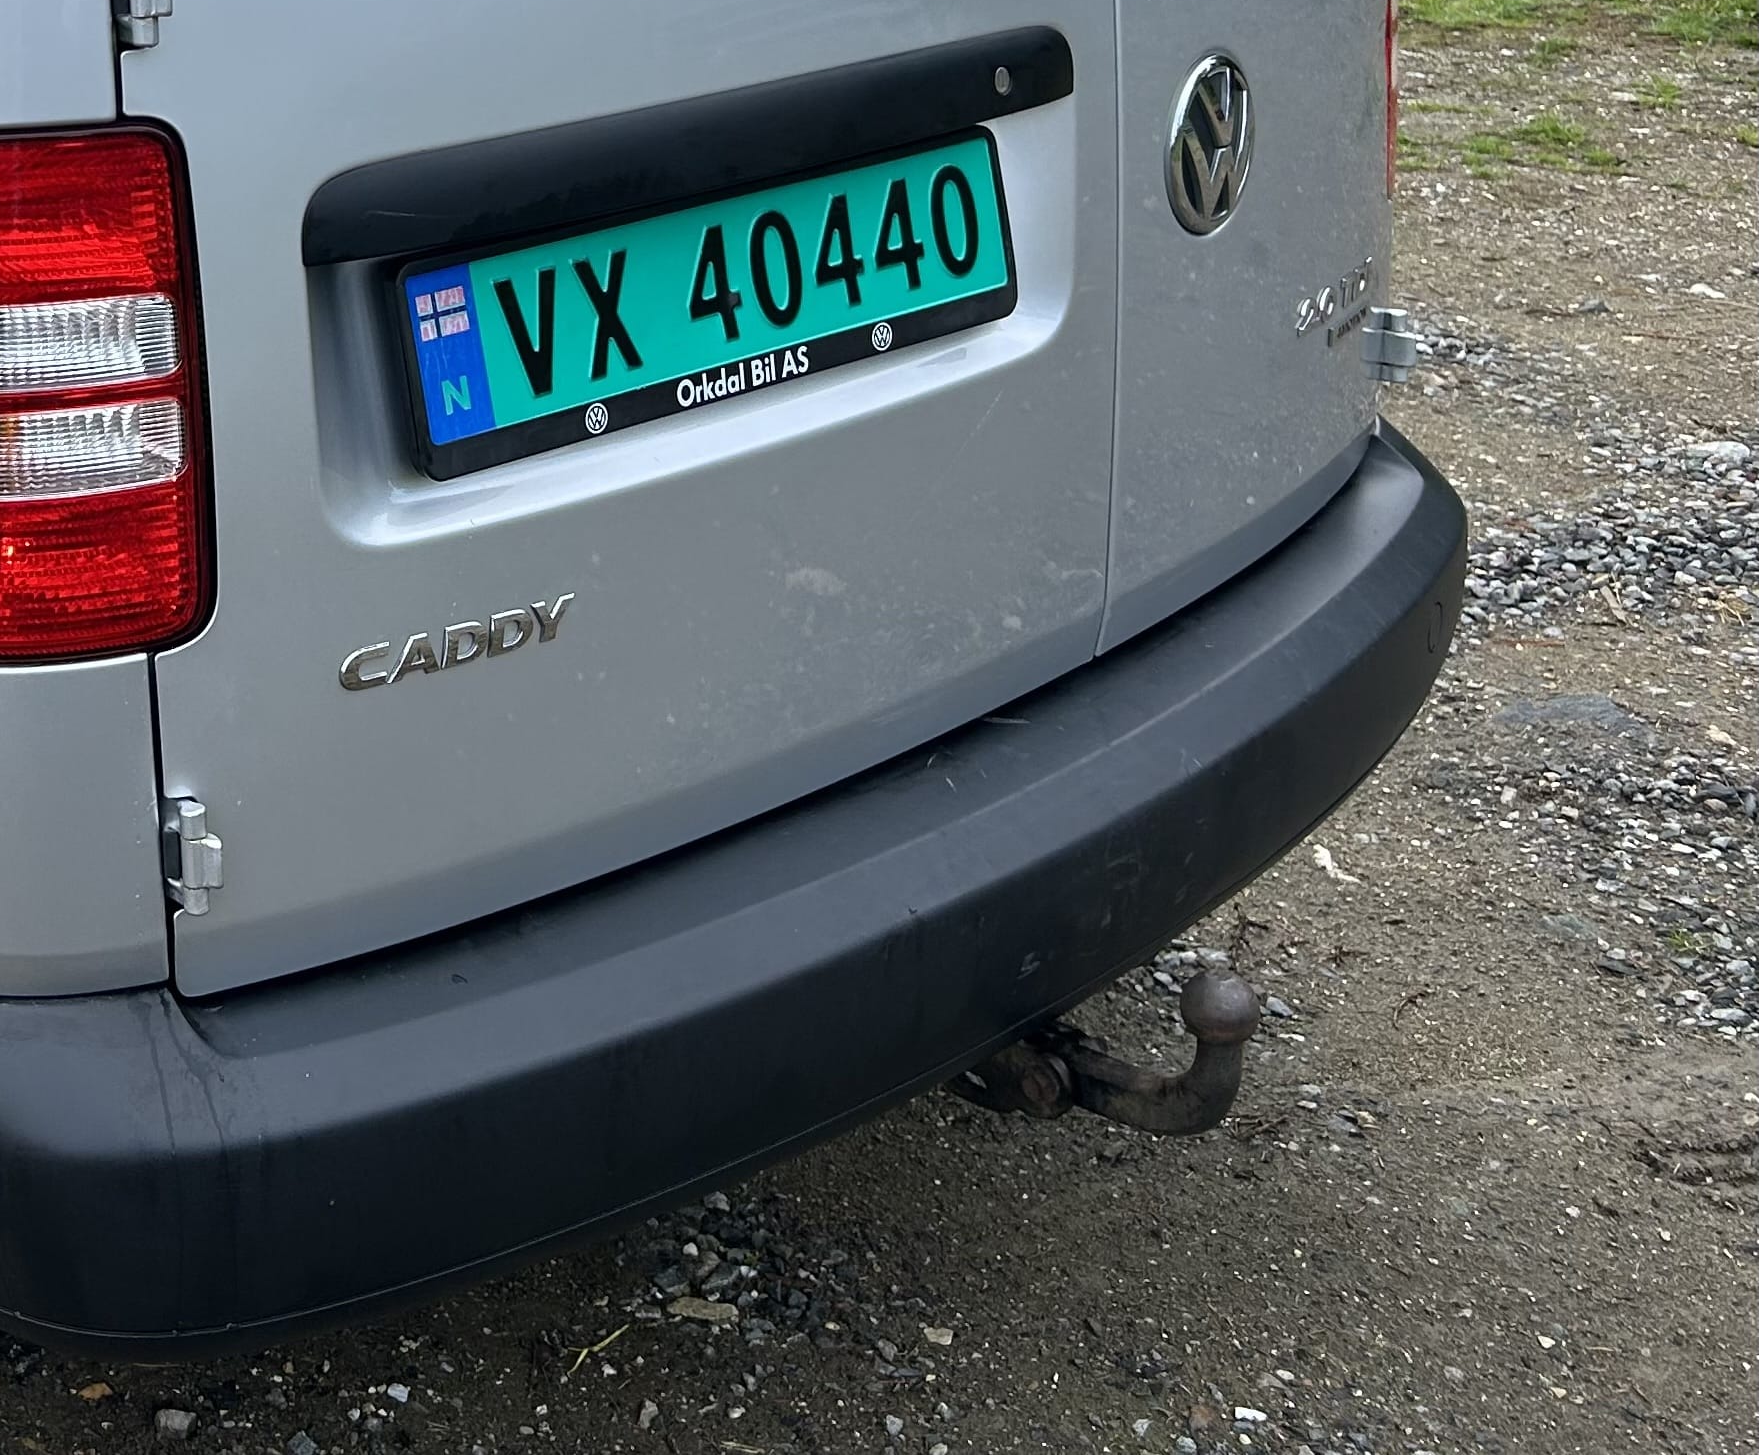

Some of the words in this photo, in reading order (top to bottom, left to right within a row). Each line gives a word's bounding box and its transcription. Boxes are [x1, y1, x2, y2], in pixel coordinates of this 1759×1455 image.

[494, 248, 644, 398] VX
[687, 163, 980, 342] 40440
[441, 375, 472, 416] N
[676, 362, 746, 408] Orkdal
[750, 353, 777, 388] Bil
[781, 345, 809, 379] AS
[338, 592, 575, 692] CADDY
